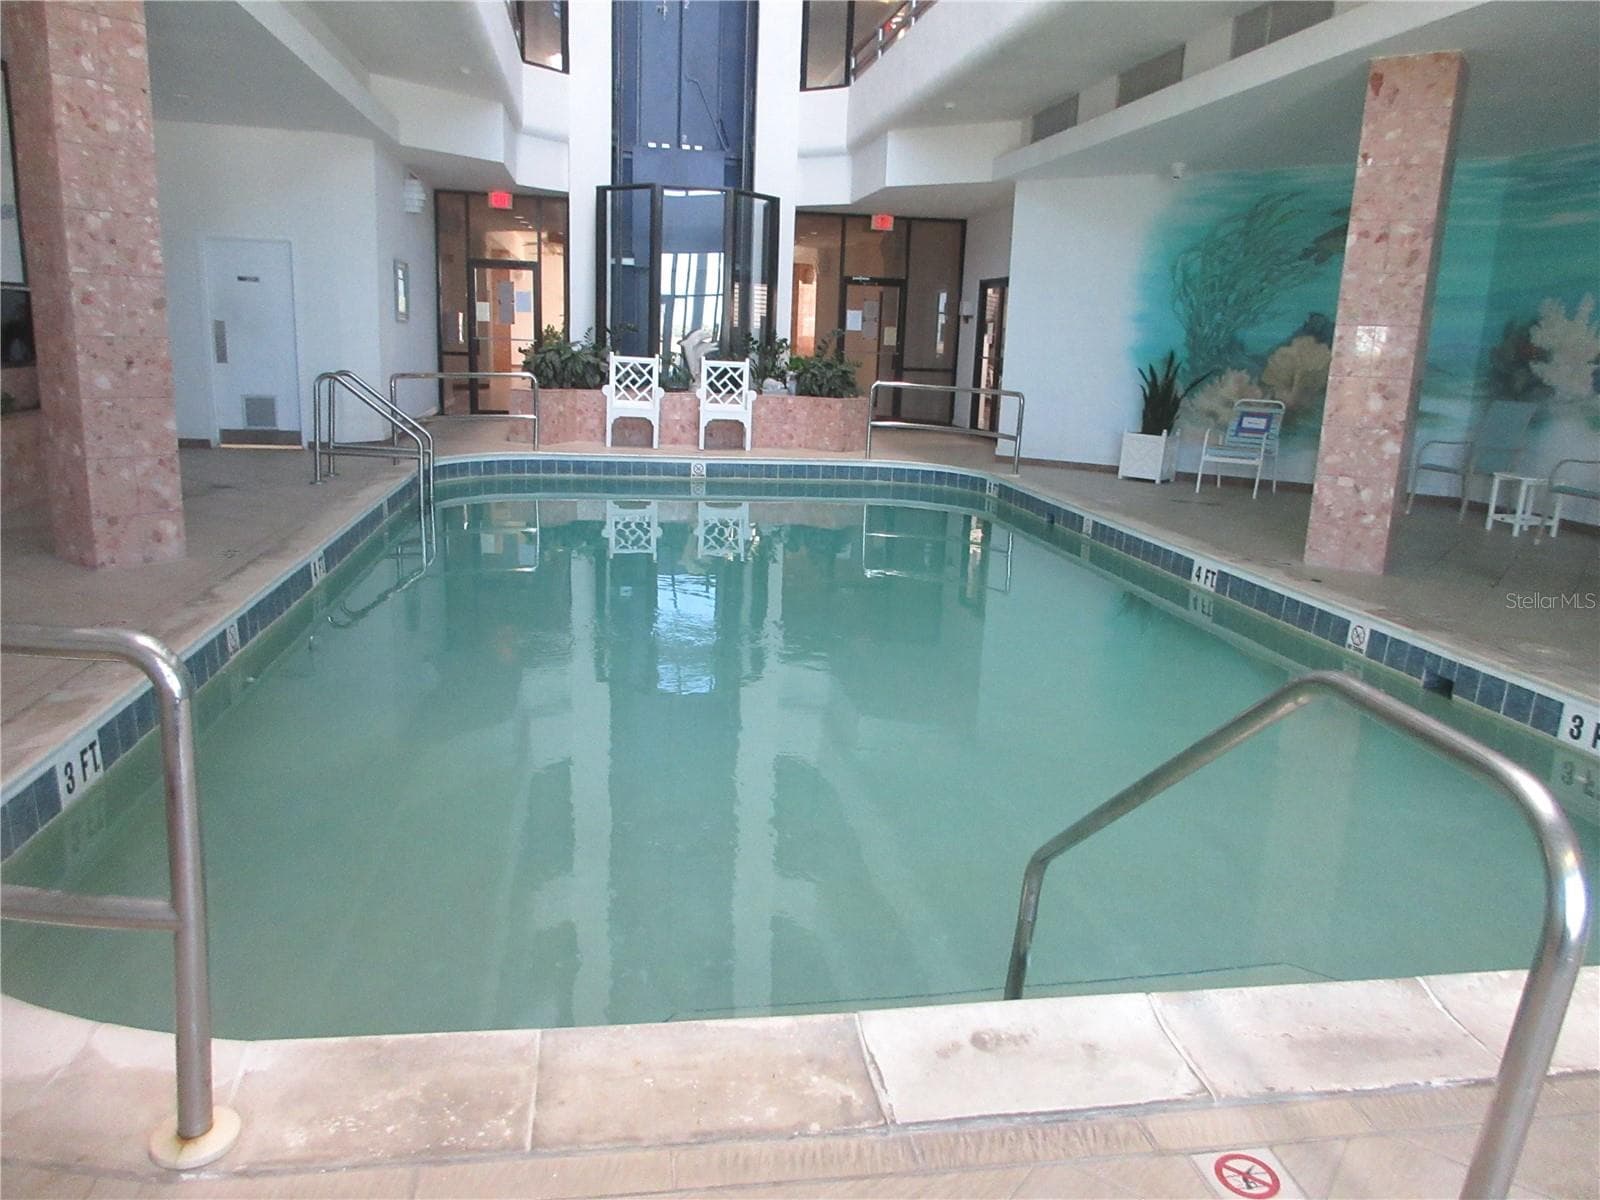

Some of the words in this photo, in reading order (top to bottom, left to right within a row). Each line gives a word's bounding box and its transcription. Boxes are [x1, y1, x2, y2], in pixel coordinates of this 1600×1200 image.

[1195, 566, 1202, 583] 4
[1569, 714, 1585, 740] 3
[64, 761, 76, 795] 3
